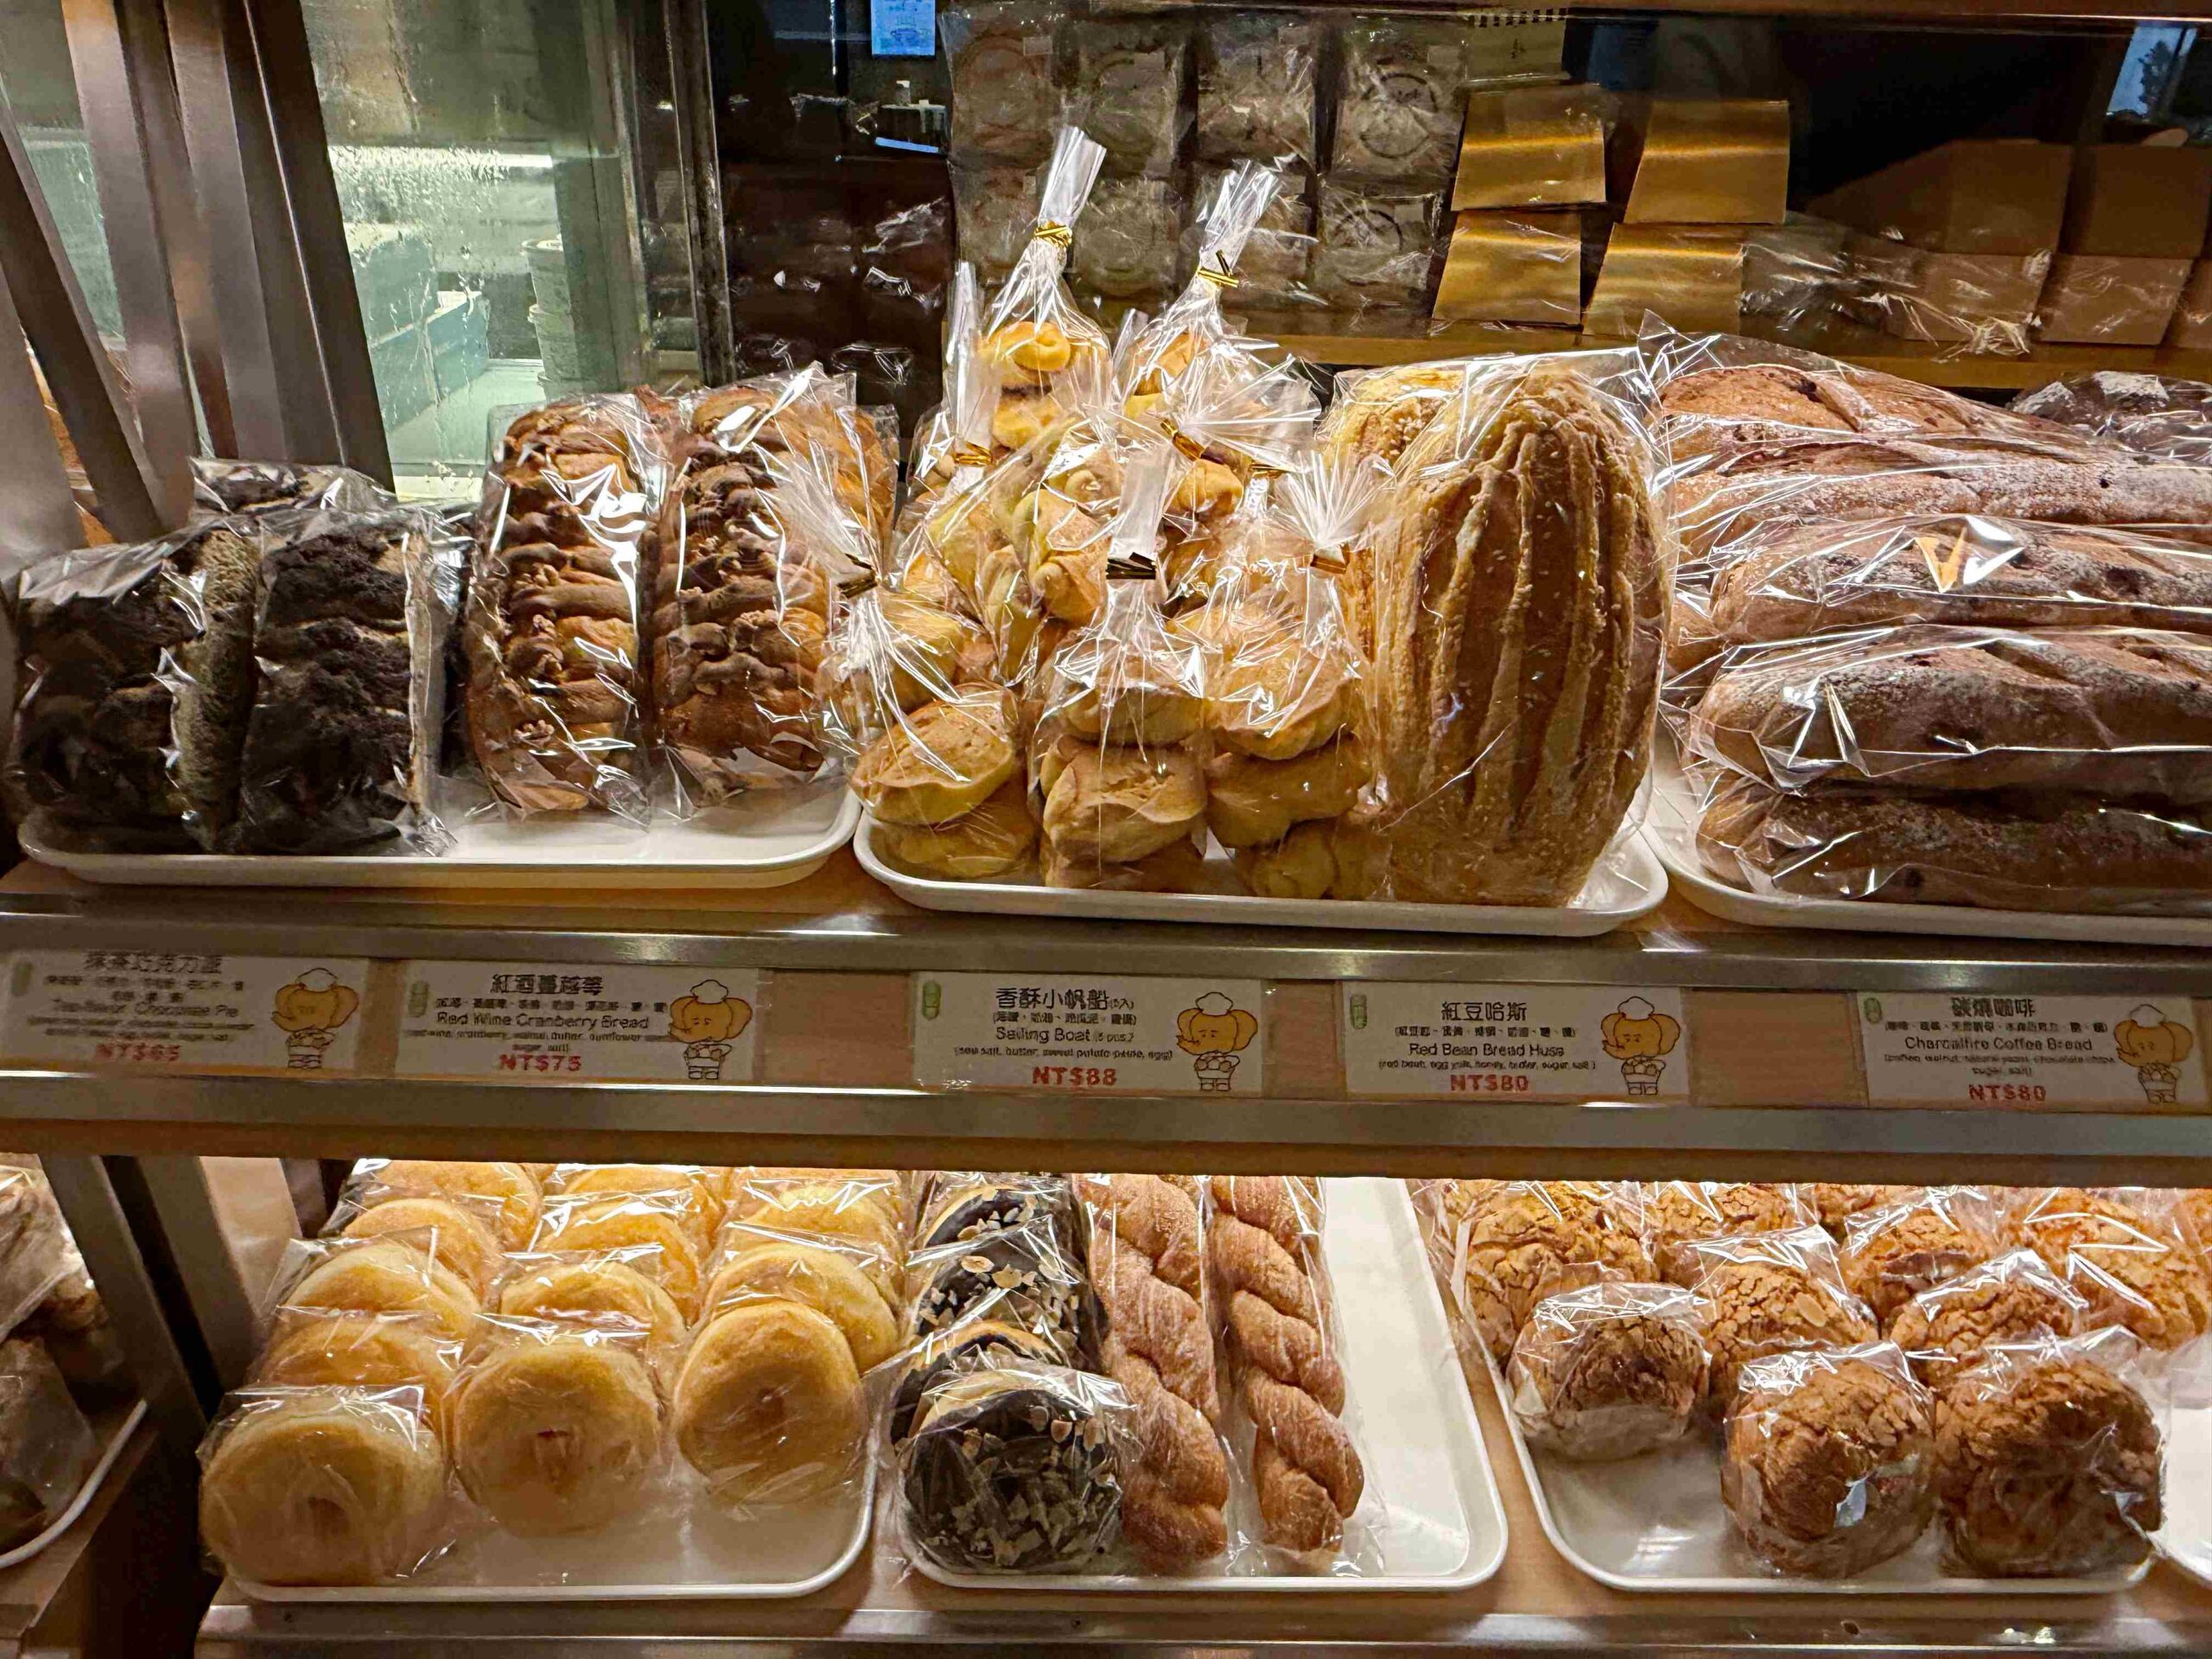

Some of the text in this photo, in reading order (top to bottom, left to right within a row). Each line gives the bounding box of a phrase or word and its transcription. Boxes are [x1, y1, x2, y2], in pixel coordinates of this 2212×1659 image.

[1441, 1001, 1528, 1021] 紅豆哈斯
[437, 1011, 649, 1031] Red Wine Cranberry Bread
[995, 1026, 1049, 1044] Sailing
[1054, 1027, 1090, 1042] Boat
[1993, 1037, 2043, 1051] Coffee
[2047, 1037, 2093, 1051] Bread
[1408, 1042, 1438, 1056] Red
[1441, 1042, 1478, 1056] Bean
[1483, 1043, 1525, 1057] Bread
[1033, 1065, 1117, 1086] NT$88
[1451, 1073, 1529, 1091] NT$80
[1968, 1084, 2046, 1101] NT$80
